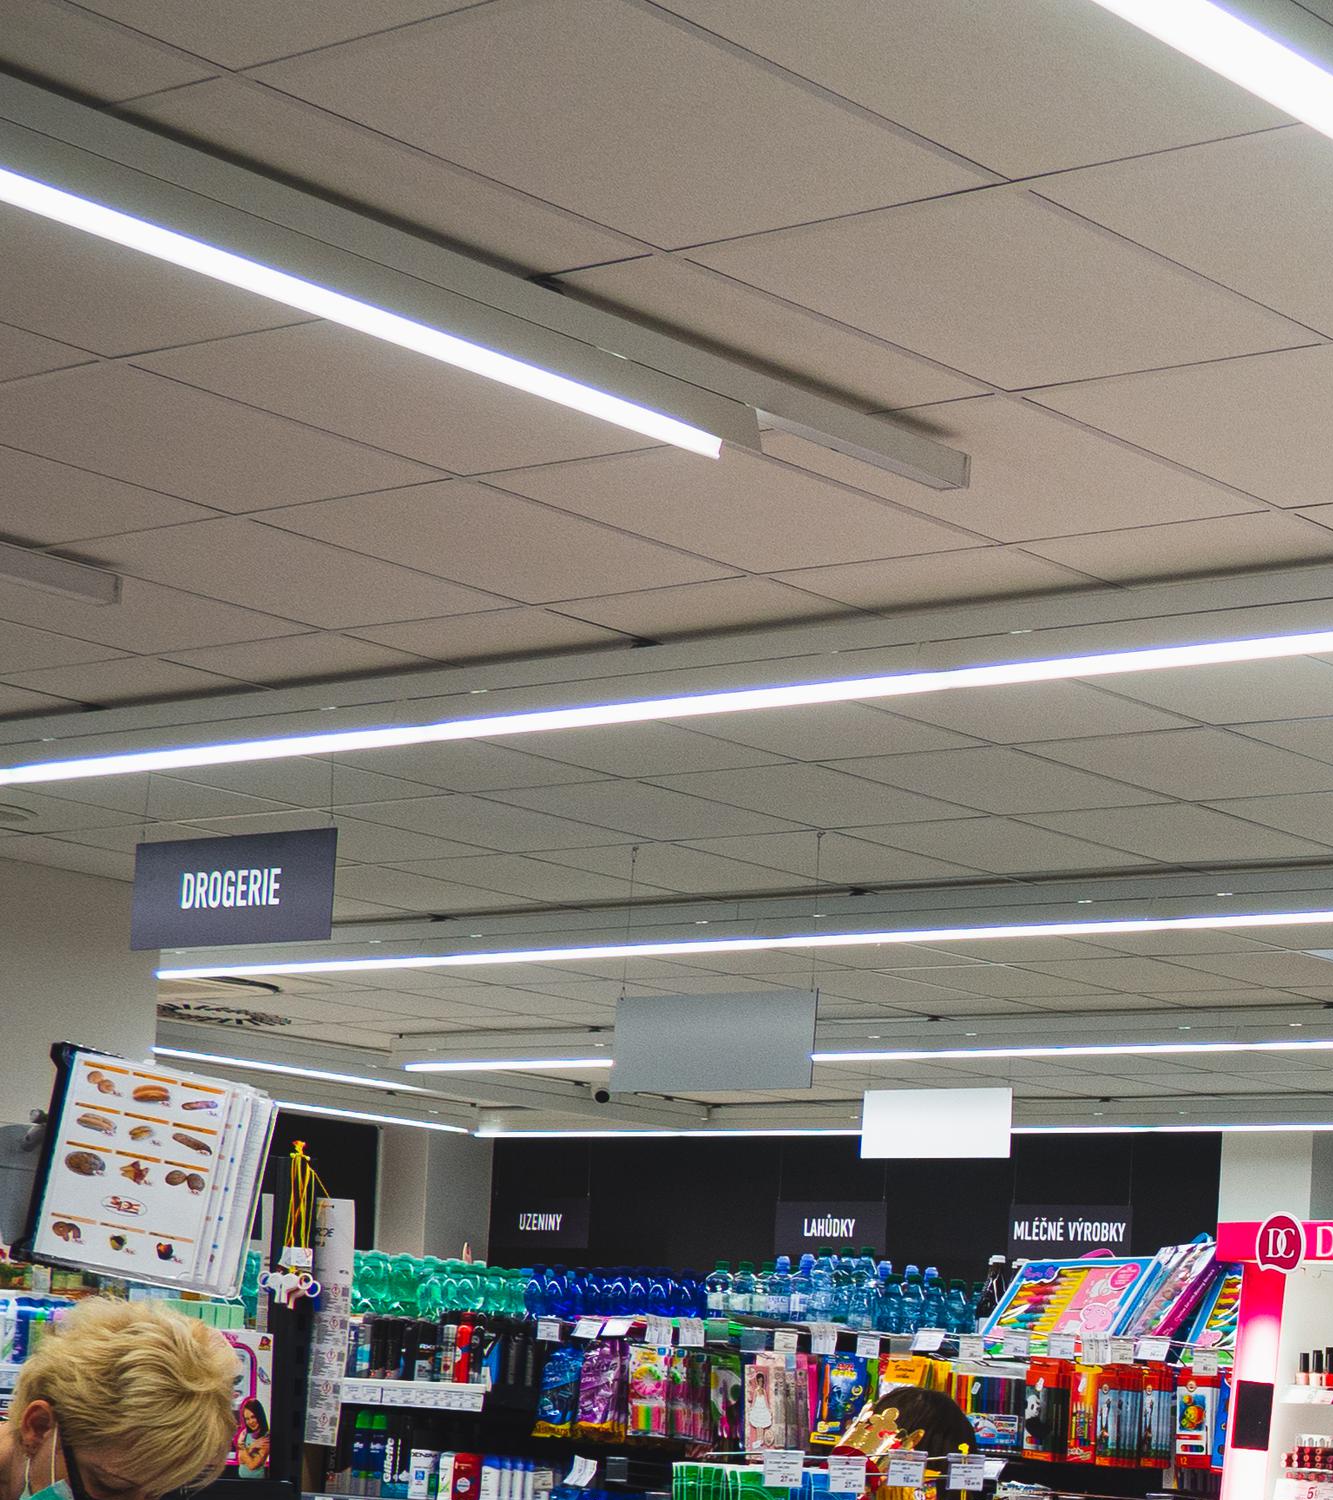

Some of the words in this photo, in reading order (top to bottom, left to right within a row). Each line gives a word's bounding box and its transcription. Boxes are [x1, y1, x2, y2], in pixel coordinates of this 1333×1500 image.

[181, 867, 281, 910] DROGERIE
[519, 1212, 562, 1232] UZENINY
[803, 1213, 856, 1238] LAHŮDKY
[1013, 1216, 1063, 1242] MLÉČNÉ
[1067, 1218, 1126, 1243] VÝROBKY
